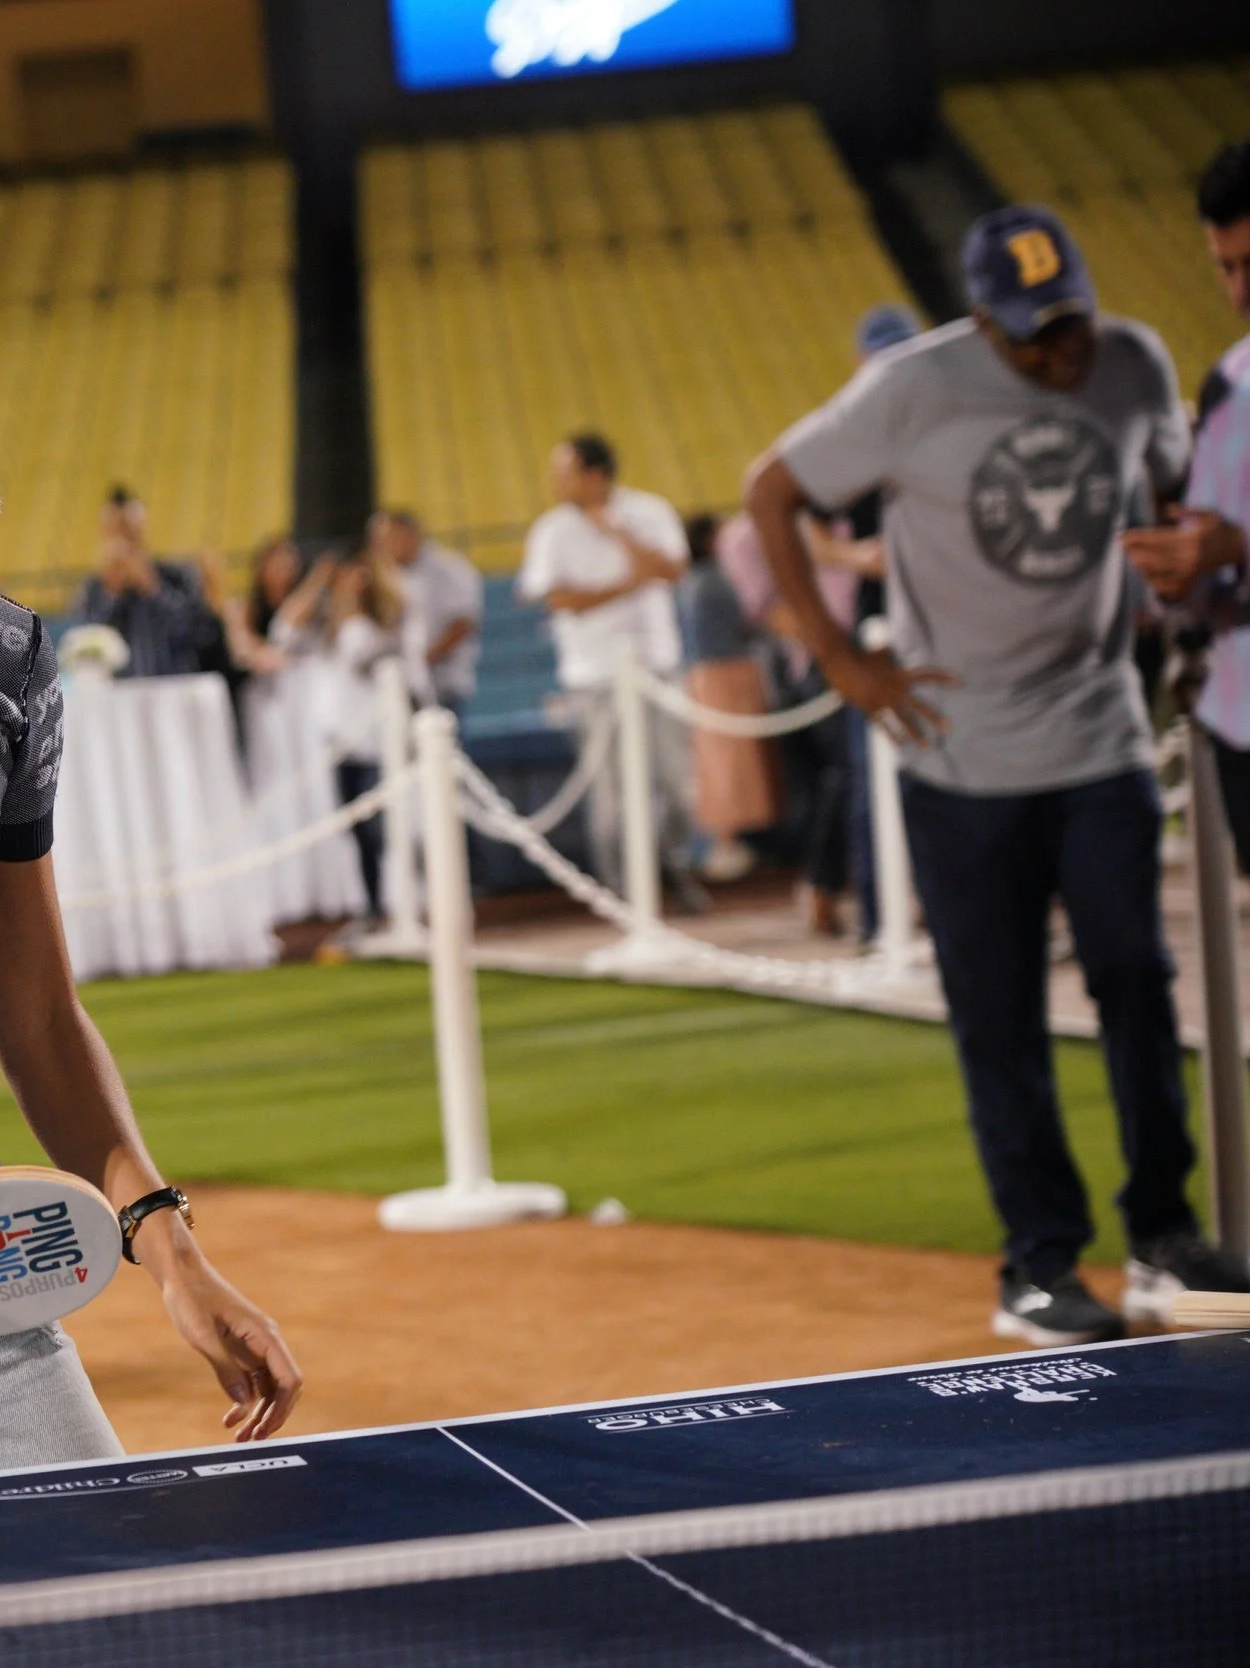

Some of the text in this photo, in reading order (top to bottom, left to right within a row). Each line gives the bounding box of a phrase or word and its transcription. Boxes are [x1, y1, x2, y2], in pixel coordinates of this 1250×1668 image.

[12, 1201, 84, 1273] PING
[74, 1266, 88, 1284] 4
[919, 1363, 1106, 1390] CHALLENGE
[595, 1402, 785, 1430] HIHO
[210, 1459, 289, 1473] UCLA
